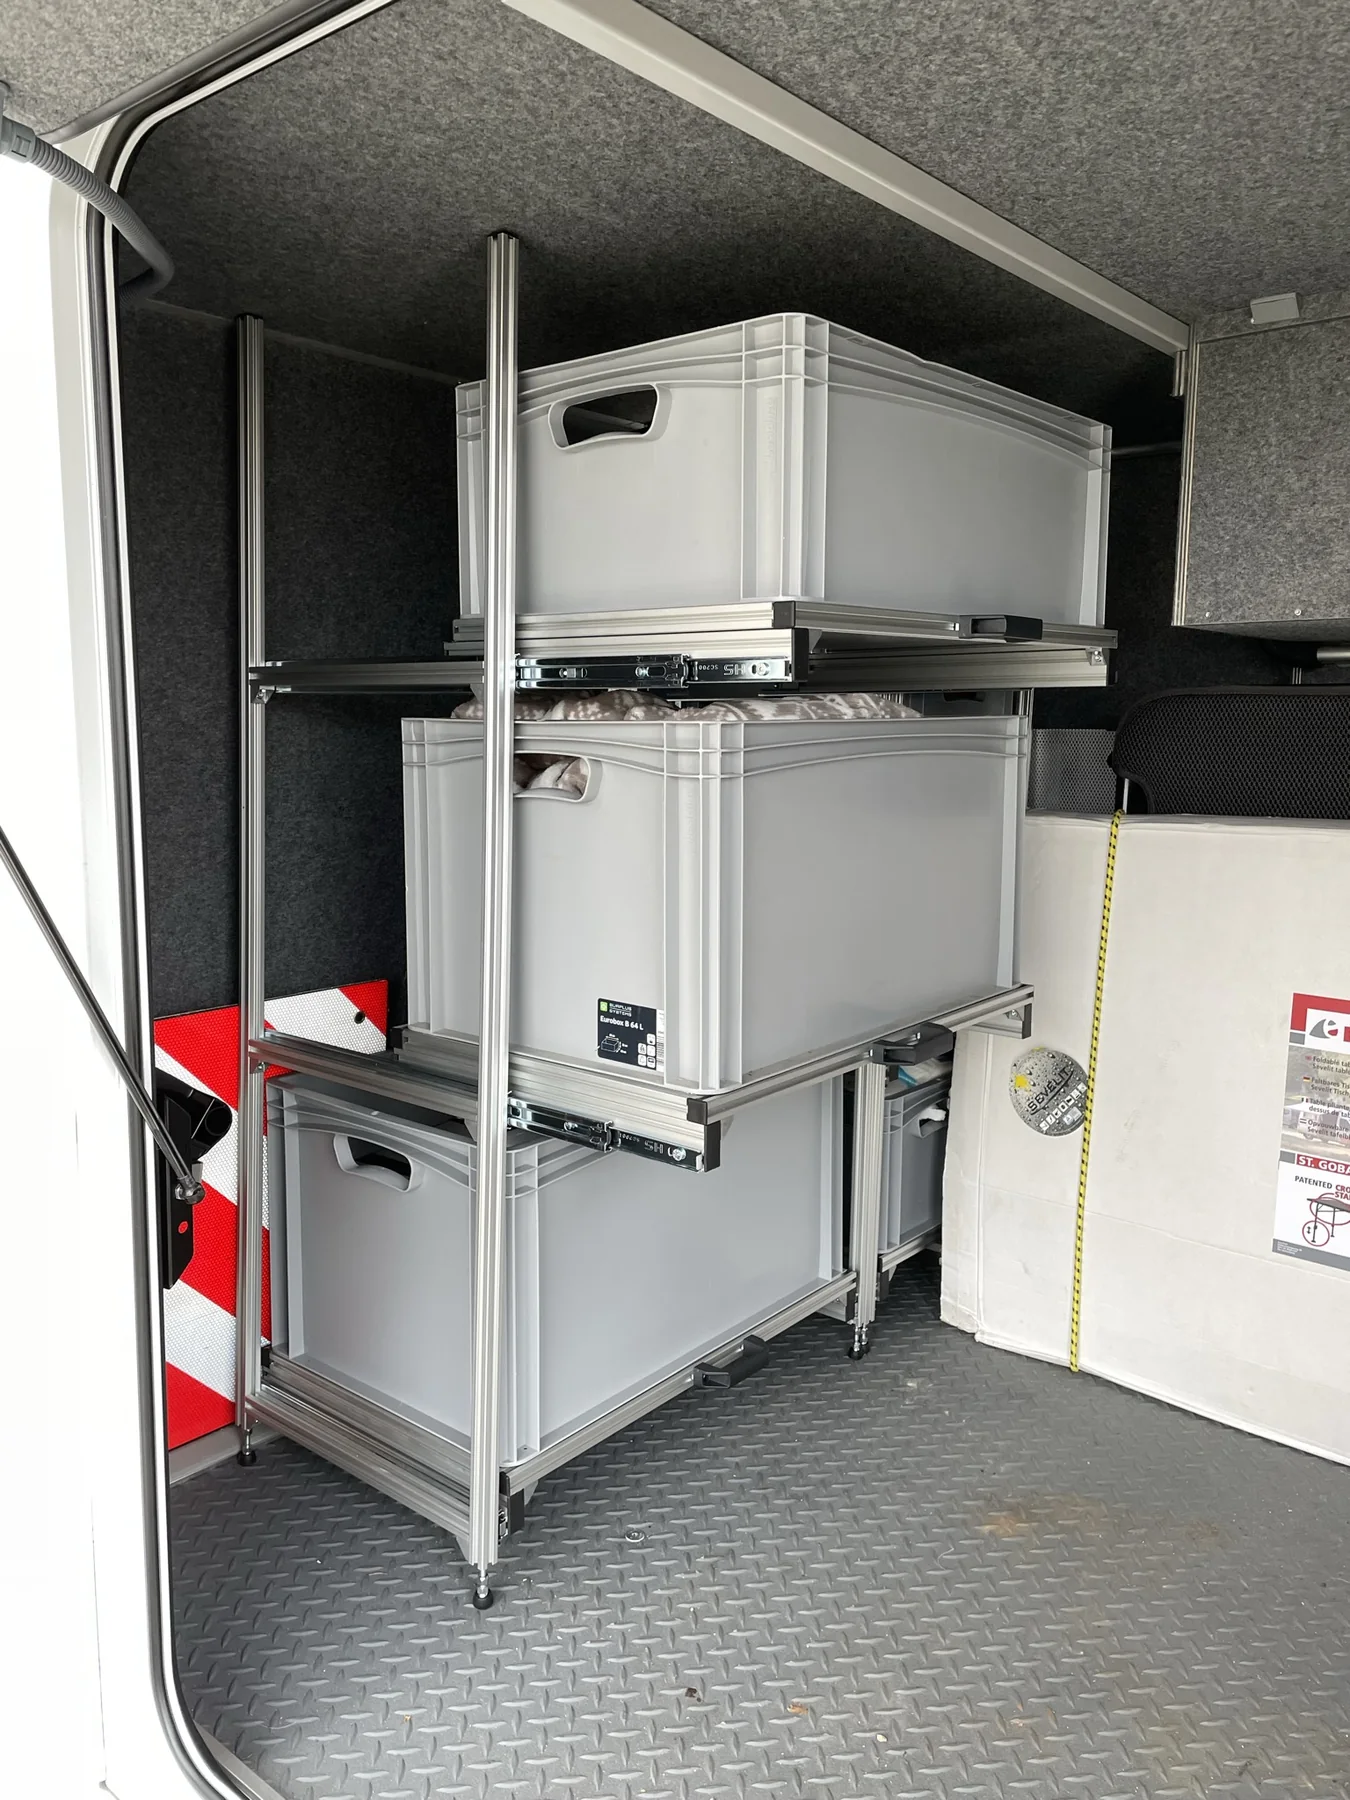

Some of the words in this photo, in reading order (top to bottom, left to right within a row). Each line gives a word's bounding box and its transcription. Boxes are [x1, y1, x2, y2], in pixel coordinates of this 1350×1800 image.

[600, 1015, 624, 1027] Eurobox
[624, 1020, 630, 1028] B
[630, 1021, 639, 1030] 64
[639, 1023, 644, 1031] L
[1313, 1056, 1340, 1066] Foldable
[1312, 1063, 1334, 1072] Sevelit
[1311, 1076, 1340, 1088] Faltbares
[1027, 1066, 1070, 1112] SEVELIT
[1311, 1084, 1333, 1093] Sevelit
[1308, 1105, 1330, 1115] dessus
[1330, 1109, 1339, 1117] de
[1307, 1119, 1350, 1132] Opvouwbare
[1307, 1126, 1329, 1136] Sevelit
[1298, 1155, 1315, 1168] ST.
[1294, 1175, 1333, 1190] PATENTED
